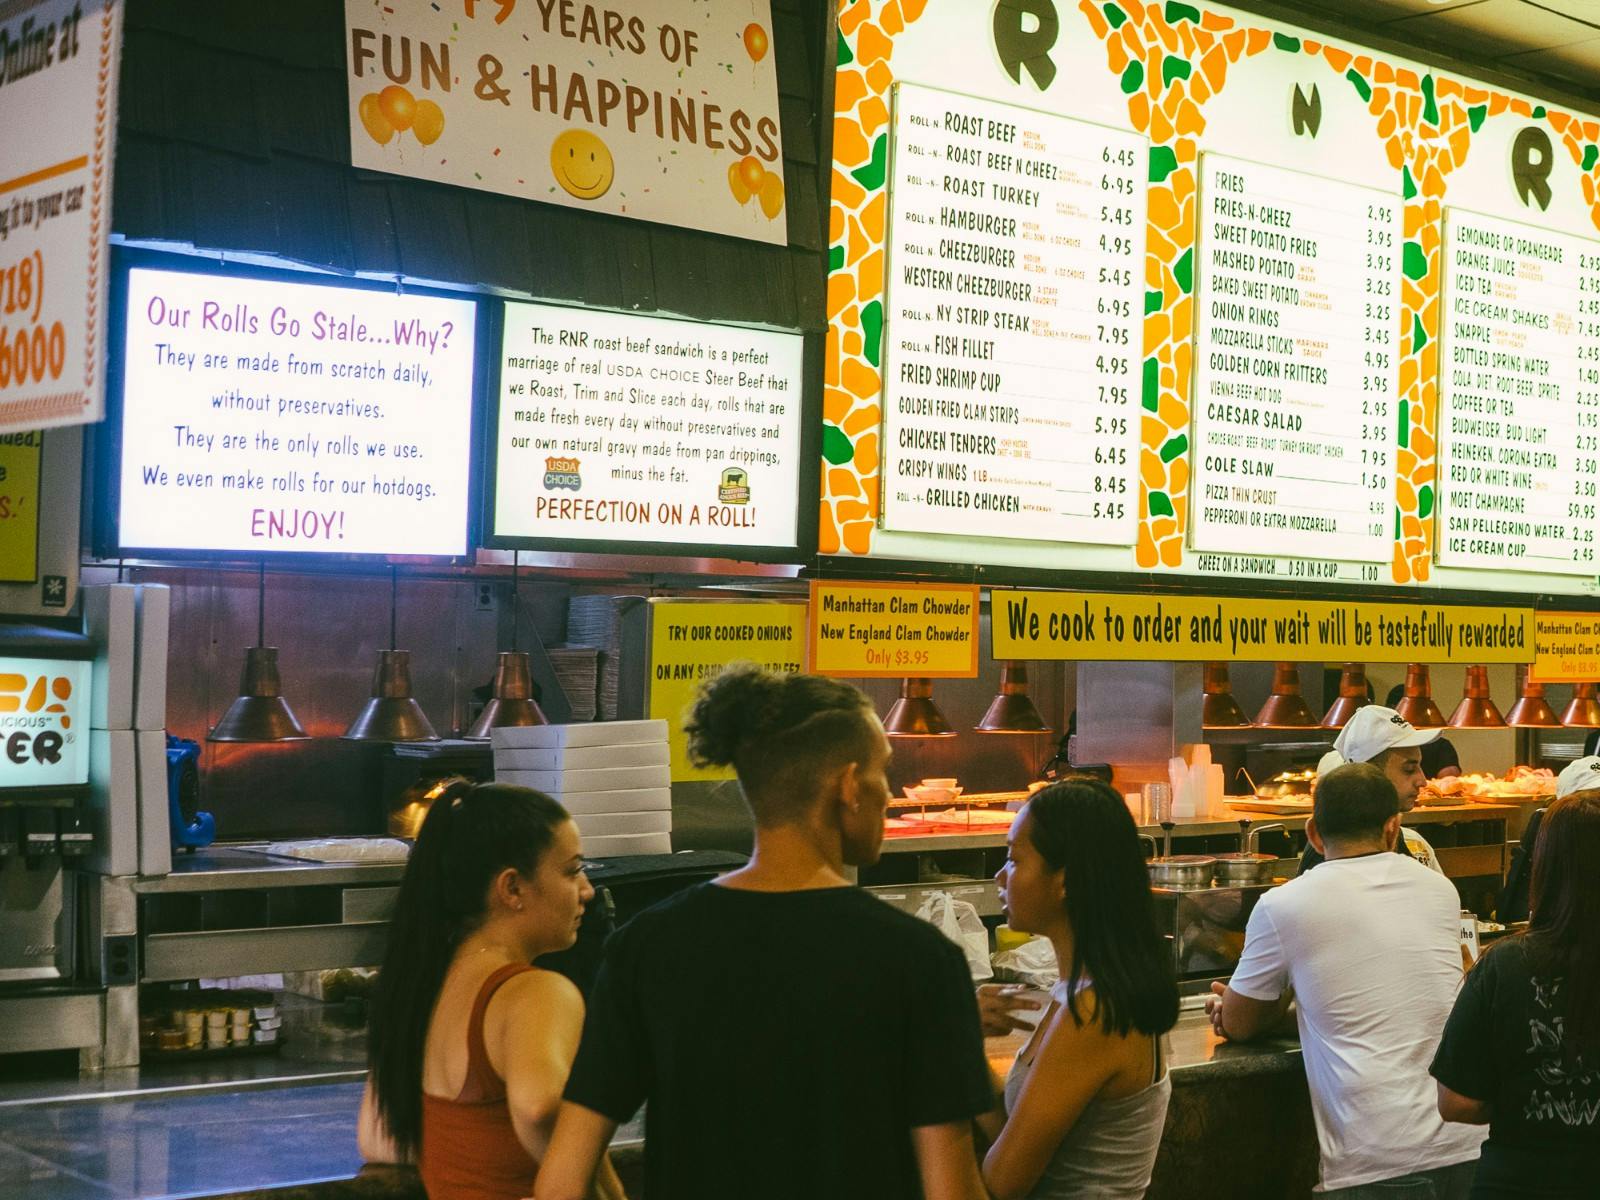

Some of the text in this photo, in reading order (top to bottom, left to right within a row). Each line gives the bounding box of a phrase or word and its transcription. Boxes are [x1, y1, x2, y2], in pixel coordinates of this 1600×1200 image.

[59, 1, 82, 62] at
[536, 0, 646, 56] YEARS
[660, 24, 698, 68] OF
[352, 28, 779, 162] FUN & HAPPINESS
[994, 0, 1553, 212] R N R
[945, 111, 983, 136] ROAST
[988, 120, 1015, 143] BEEF
[1102, 146, 1133, 166] 6.45
[943, 175, 984, 197] ROAST
[992, 184, 1039, 207] TURKEY
[1101, 206, 1131, 225] 5.45
[1214, 197, 1391, 247] FRIES-N-CHEEZ 3.95
[939, 239, 1014, 268] CHEEZBURGER
[1099, 267, 1130, 286] 5.45
[147, 296, 453, 354] Our Rolls Go Stale...Why?
[1212, 301, 1389, 344] ONION RINGS 3.45
[1454, 297, 1599, 337] ICE CREAM SHAKES 7.45
[532, 327, 768, 365] The RNR roast beef sandwich is a perfect
[154, 344, 432, 387] They are made from scratch daily,
[508, 357, 788, 391] marriage of real USDA CHOICE Steer Beef that
[901, 363, 1127, 405] FRIED SHRIMP CUP 7.95
[212, 389, 384, 418] without preservatives.
[1207, 404, 1386, 441] CAESAR SALAD 3.95
[174, 425, 422, 458] They are the only rolls we use.
[545, 474, 579, 486] CHOICE
[548, 460, 577, 472] USDA
[1205, 456, 1386, 489] COLE SLAW 1.50
[536, 496, 755, 527] PERFECTION ON A ROLL!
[926, 488, 1124, 519] GRILLED CHICKEN 5.45
[251, 508, 344, 539] ENJOY!
[1449, 516, 1593, 542] SAN PELLEGRINO WATER 2.25
[1449, 538, 1593, 560] ICE CREAM CUP 2.45
[823, 594, 970, 615] Manhattan Clam Chowder
[668, 625, 792, 640] TRY OUR COOKED ONIONS
[821, 623, 969, 644] New England Clam Chowder
[1008, 597, 1524, 657] We cook to order and your wait will be tastefully rewarded
[1537, 621, 1572, 634] Manhattan
[1574, 622, 1591, 634] Clam
[866, 648, 928, 668] Only $3.95
[1536, 642, 1549, 654] New
[1552, 642, 1576, 657] England
[1578, 643, 1593, 655] Clam
[656, 664, 670, 680] ON
[673, 664, 694, 679] ANY
